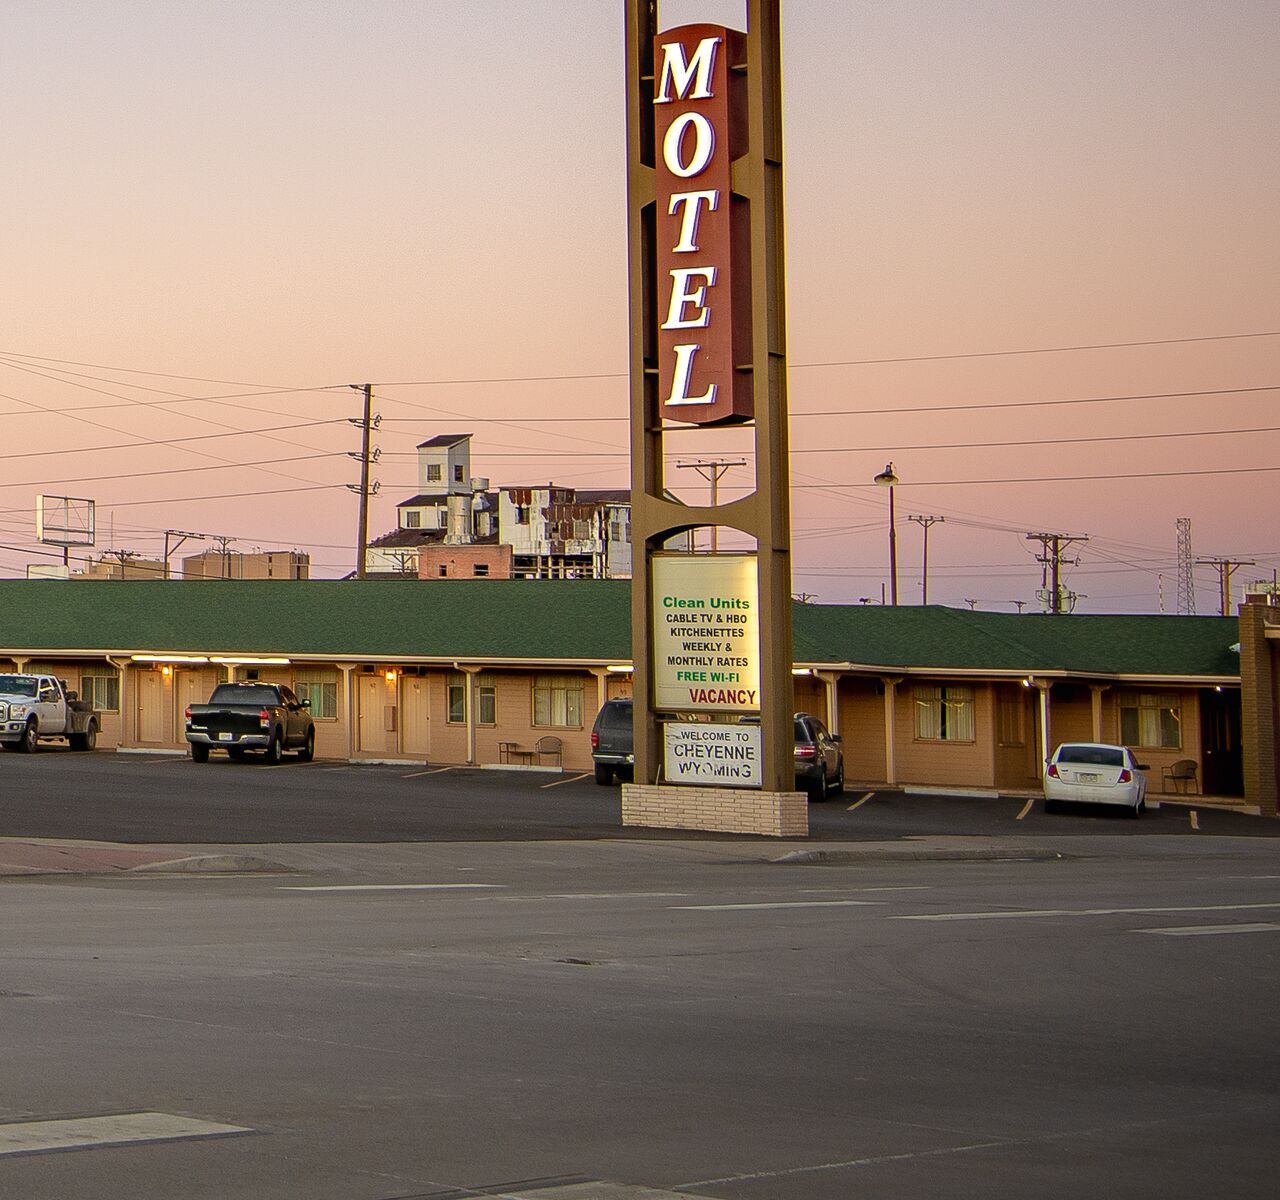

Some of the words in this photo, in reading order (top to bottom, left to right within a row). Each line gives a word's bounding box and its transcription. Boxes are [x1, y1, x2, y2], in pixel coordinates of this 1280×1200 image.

[653, 37, 722, 407] MOTEL
[663, 596, 705, 608] Clean
[710, 598, 750, 609] Units
[666, 614, 698, 623] CABLE
[700, 614, 713, 623] TV
[716, 614, 723, 623] &
[726, 615, 747, 624] HBO
[670, 628, 744, 637] KITCHENETTES
[682, 642, 722, 651] WEEKLY
[725, 643, 732, 651] &
[667, 656, 714, 666] MONTHLY
[717, 657, 748, 667] RATES
[677, 672, 707, 681] FREE
[710, 672, 740, 682] WI-FI
[689, 689, 756, 705] VACANCY
[681, 731, 731, 741] WELCOME
[736, 733, 749, 742] TO
[674, 744, 755, 760] CHEYENNE
